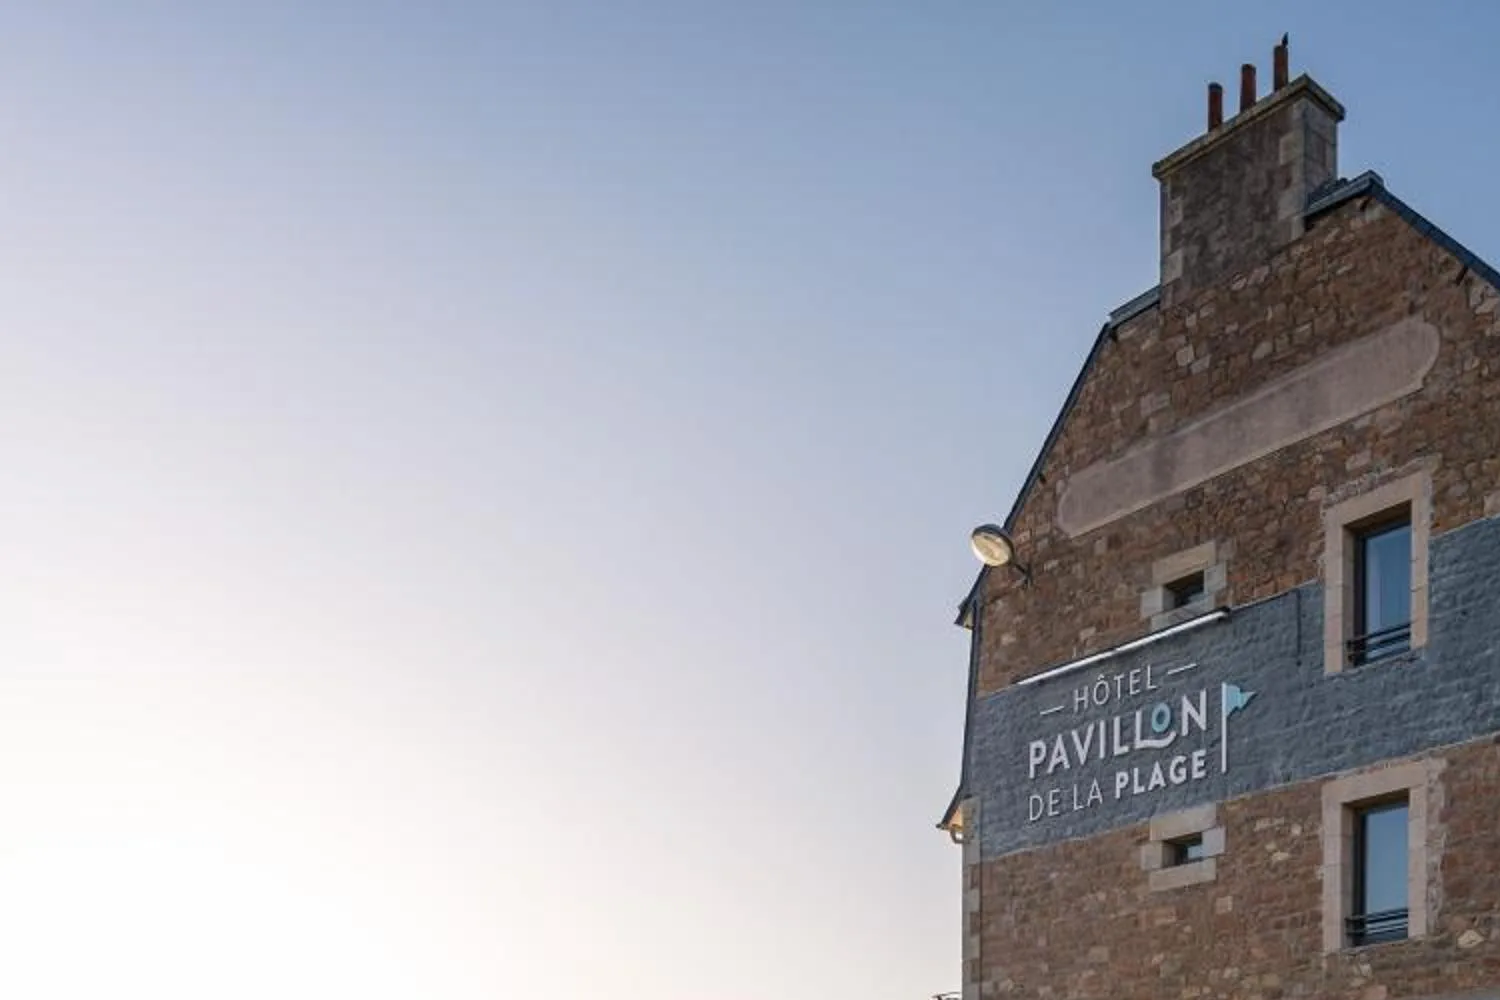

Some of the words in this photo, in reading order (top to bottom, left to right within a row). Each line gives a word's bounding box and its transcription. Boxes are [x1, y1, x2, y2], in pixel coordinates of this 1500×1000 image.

[1073, 664, 1158, 714] HÔTEL
[1028, 688, 1208, 779] PAVILLON
[1028, 788, 1061, 822] DE
[1073, 778, 1103, 811] LA
[1115, 748, 1207, 799] PLAGE
